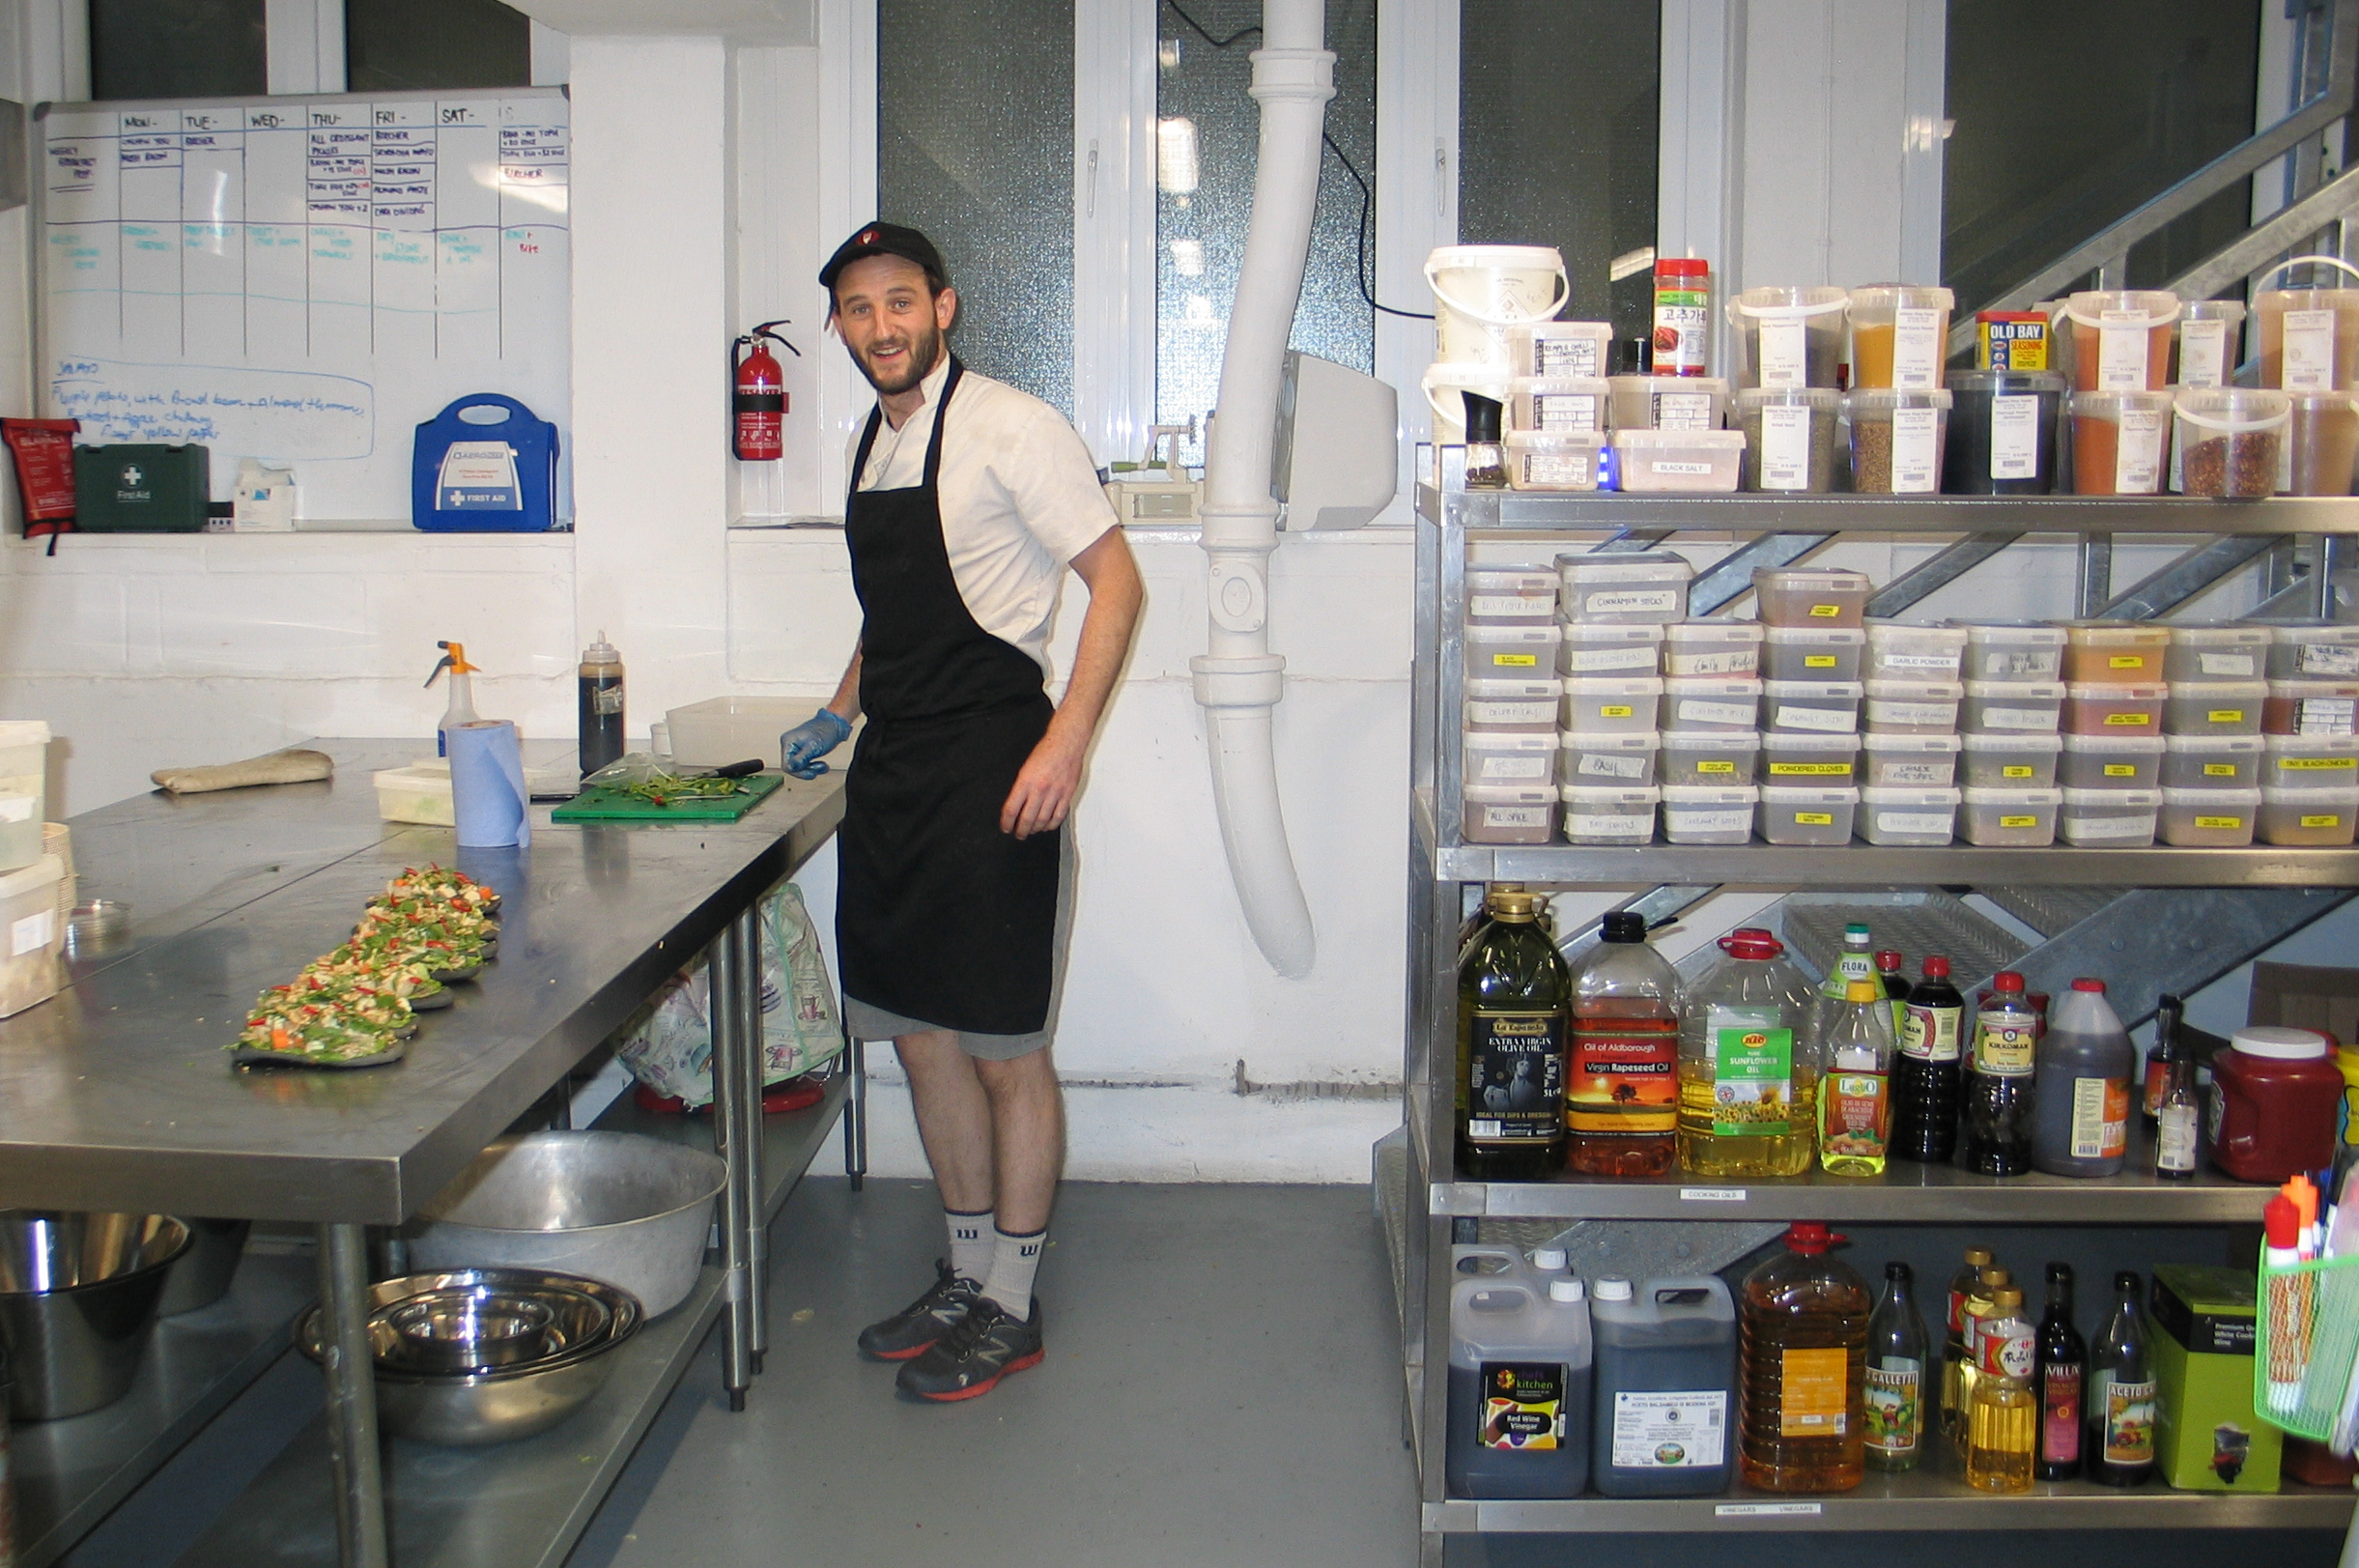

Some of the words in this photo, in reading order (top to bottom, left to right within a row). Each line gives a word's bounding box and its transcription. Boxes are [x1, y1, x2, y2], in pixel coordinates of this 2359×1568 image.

[1990, 324, 2014, 340] OLD
[2017, 324, 2041, 339] BAY
[2009, 339, 2042, 352] SEASONING
[1660, 464, 1683, 472] BLACK
[1685, 464, 1703, 472] SALT
[467, 492, 490, 502] FIRST
[492, 492, 507, 501] AID
[1597, 597, 1638, 608] CINNAMON
[1919, 658, 1950, 667] POWDER
[1777, 764, 1816, 773] POWDERED
[1817, 764, 1844, 773] CLOVES
[1841, 961, 1868, 972] FLORA
[1489, 1037, 1519, 1045] EXTRA
[1521, 1037, 1551, 1045] VIRGIN
[1583, 1042, 1596, 1051] Oil
[1597, 1042, 1606, 1051] of
[1607, 1042, 1656, 1053] Aldborough
[1729, 1057, 1778, 1066] SUNFLOWER
[1586, 1063, 1610, 1072] Virgin
[1611, 1063, 1656, 1073] Rapeseed
[1656, 1063, 1669, 1071] Oil
[1688, 1190, 1720, 1199] COOKING
[1720, 1190, 1738, 1199] OILS
[2214, 1329, 2235, 1338] White
[1872, 1372, 1916, 1384] GALLETTI
[1516, 1379, 1553, 1389] kitchen
[2109, 1383, 2143, 1397] ACETO
[1510, 1422, 1538, 1431] Vinegar
